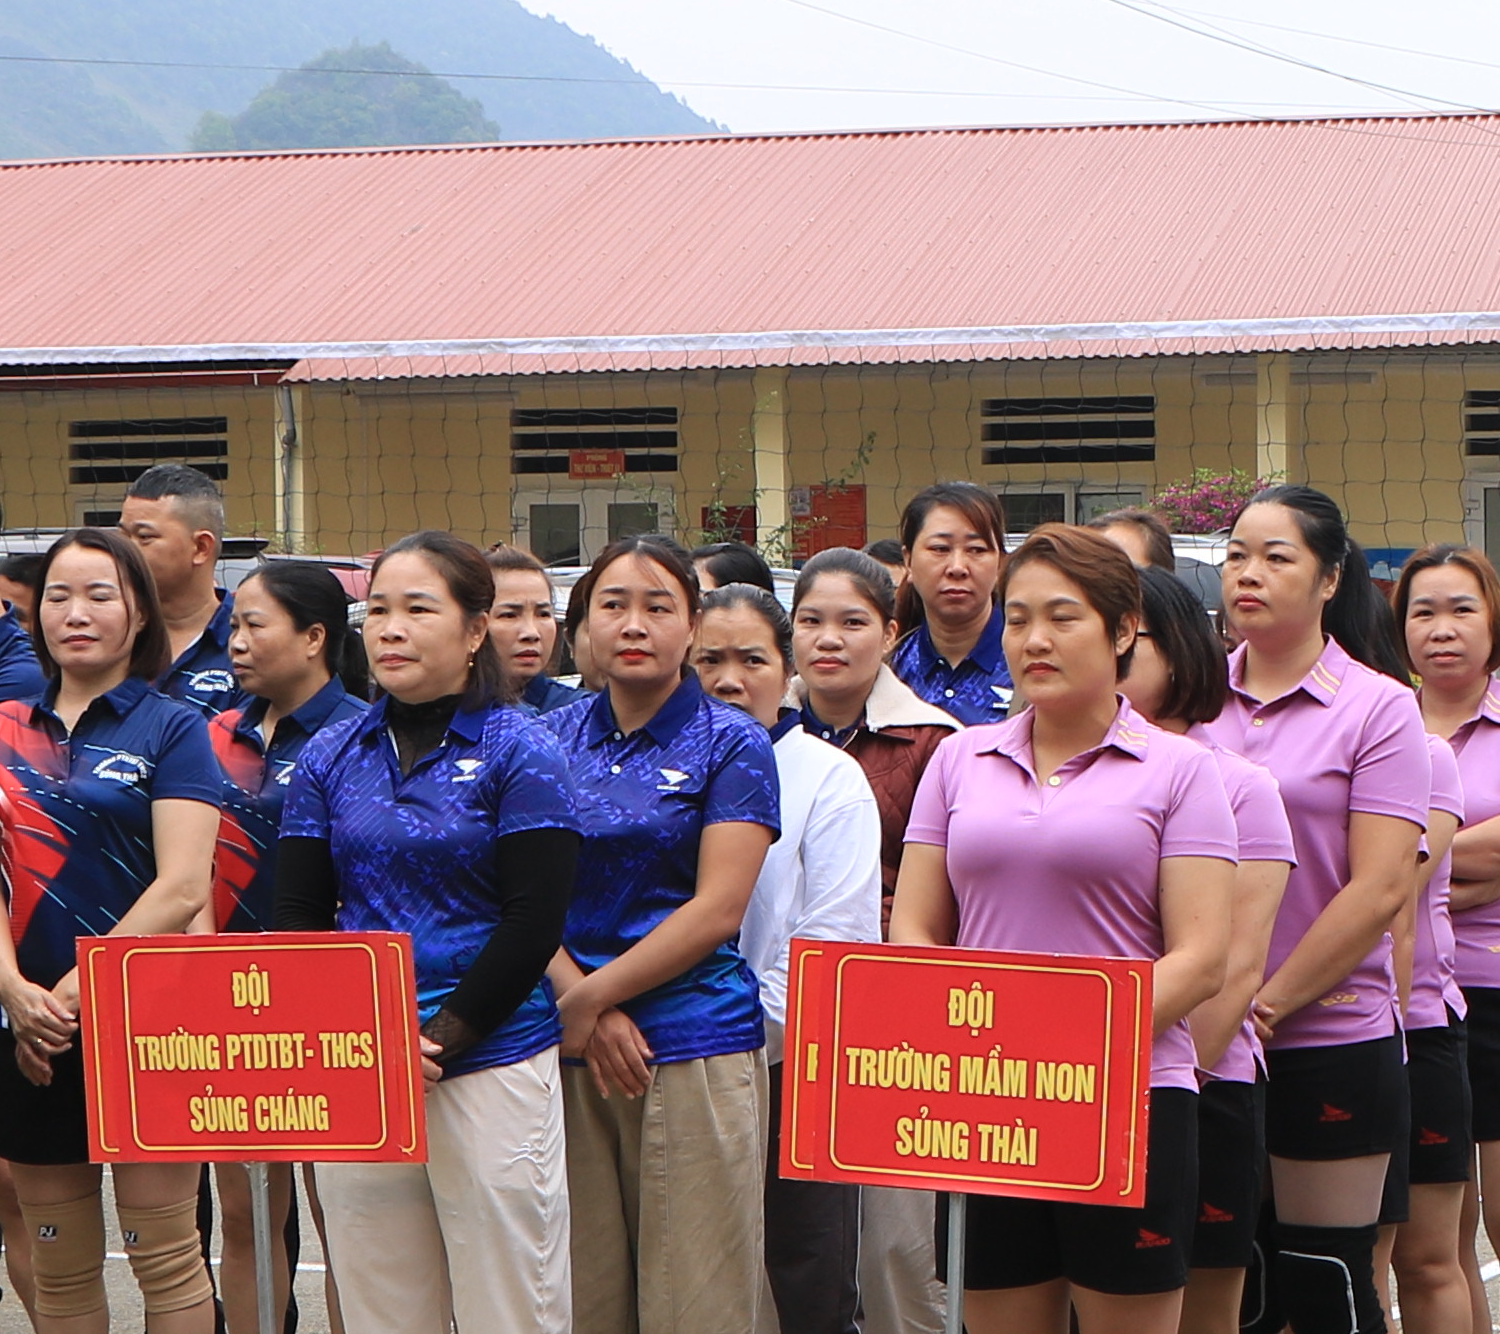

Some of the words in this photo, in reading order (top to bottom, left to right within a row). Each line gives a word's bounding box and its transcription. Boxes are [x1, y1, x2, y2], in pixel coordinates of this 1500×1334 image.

[231, 963, 270, 1015] ĐỘI
[947, 981, 994, 1037] ĐỘI
[134, 1026, 221, 1071] TRƯỜNG
[225, 1032, 314, 1070] PTDTBT-
[318, 1031, 375, 1069] THCS
[845, 1041, 951, 1092] TRƯỜNG
[958, 1044, 1028, 1098] MẦM
[1035, 1061, 1096, 1104] NON
[189, 1084, 249, 1133] SỦNG
[254, 1087, 330, 1132] CHÁNG
[895, 1105, 970, 1161] SỦNG
[977, 1118, 1038, 1166] THÀI
